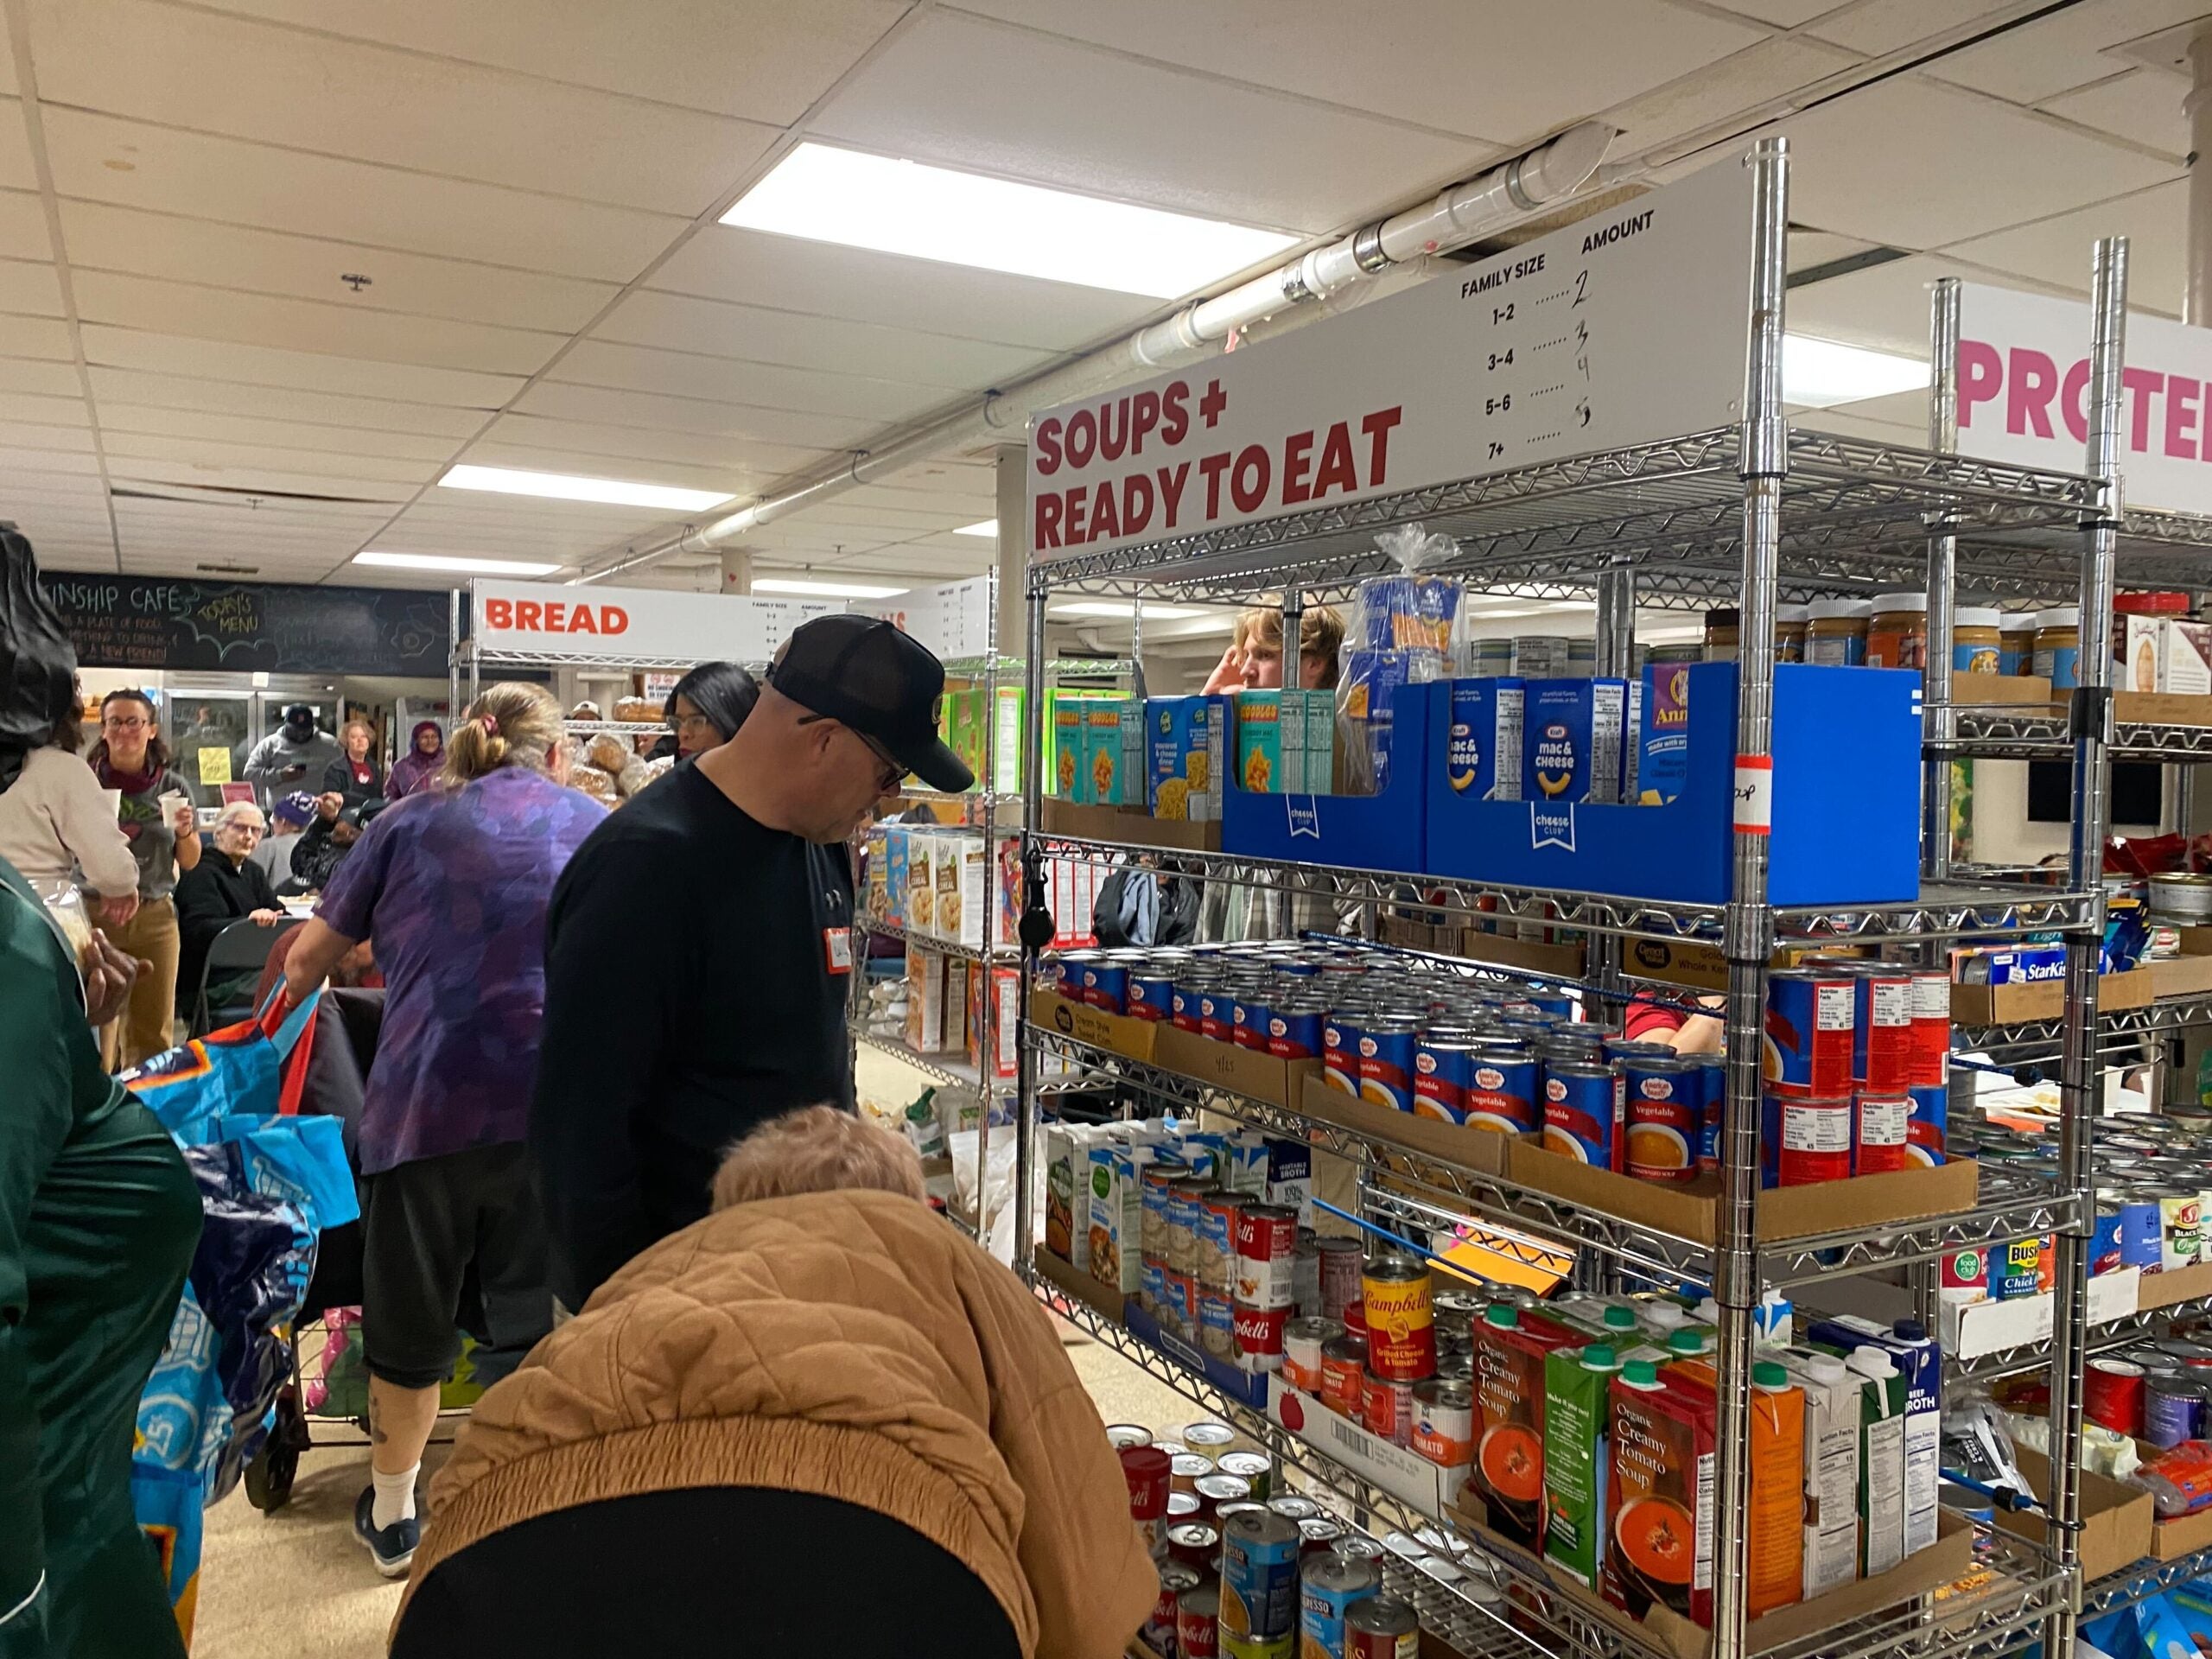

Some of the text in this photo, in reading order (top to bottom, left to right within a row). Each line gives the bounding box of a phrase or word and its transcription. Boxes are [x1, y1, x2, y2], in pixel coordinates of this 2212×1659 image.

[1581, 210, 1655, 255] AMOUNT
[1461, 253, 1546, 299] FAMILY SIZE
[1571, 270, 1593, 309] 2
[1493, 303, 1515, 325] 1-2
[1488, 348, 1514, 372] 3-4
[1577, 353, 1590, 382] 4
[1485, 394, 1510, 415] 5-6
[1036, 380, 1190, 475] SOUPS
[1488, 442, 1504, 460] 7+
[1036, 405, 1402, 550] READY TO EAT
[48, 583, 118, 613] INSHIP
[219, 614, 259, 633] MENU
[486, 598, 629, 636] BREAD
[1467, 739, 1477, 753] &
[1539, 741, 1573, 755] mac &
[1663, 740, 1678, 748] with
[1450, 753, 1479, 765] eese
[1535, 814, 1569, 827] cheese
[1478, 1071, 1502, 1081] American
[1644, 1078, 1669, 1090] American
[1471, 1094, 1507, 1109] Vegetable
[1646, 1087, 1667, 1097] Beauty
[1635, 1104, 1675, 1118] Vegetable
[1279, 1162, 1306, 1171] VEGETABLE
[1281, 1168, 1306, 1179] BROTH
[2175, 1229, 2196, 1237] BLACK
[1960, 1258, 1977, 1267] food
[1961, 1266, 1976, 1274] club
[2005, 1276, 2034, 1288] Chick
[1234, 1319, 1269, 1340] pbell's
[1376, 1348, 1425, 1358] Grilled Cheese
[1478, 1339, 1510, 1364] Organic
[1390, 1357, 1419, 1367] Tomato
[1478, 1356, 1521, 1384] Creamy
[1478, 1373, 1521, 1405] Tomato
[1909, 1389, 1925, 1400] BEEF
[1478, 1390, 1508, 1419] Soup
[1616, 1401, 1653, 1429] Organic
[1413, 1433, 1444, 1455] TOMATO
[1617, 1420, 1666, 1456] Creamy
[1617, 1436, 1666, 1476] Tomato
[1616, 1459, 1649, 1490] Soup
